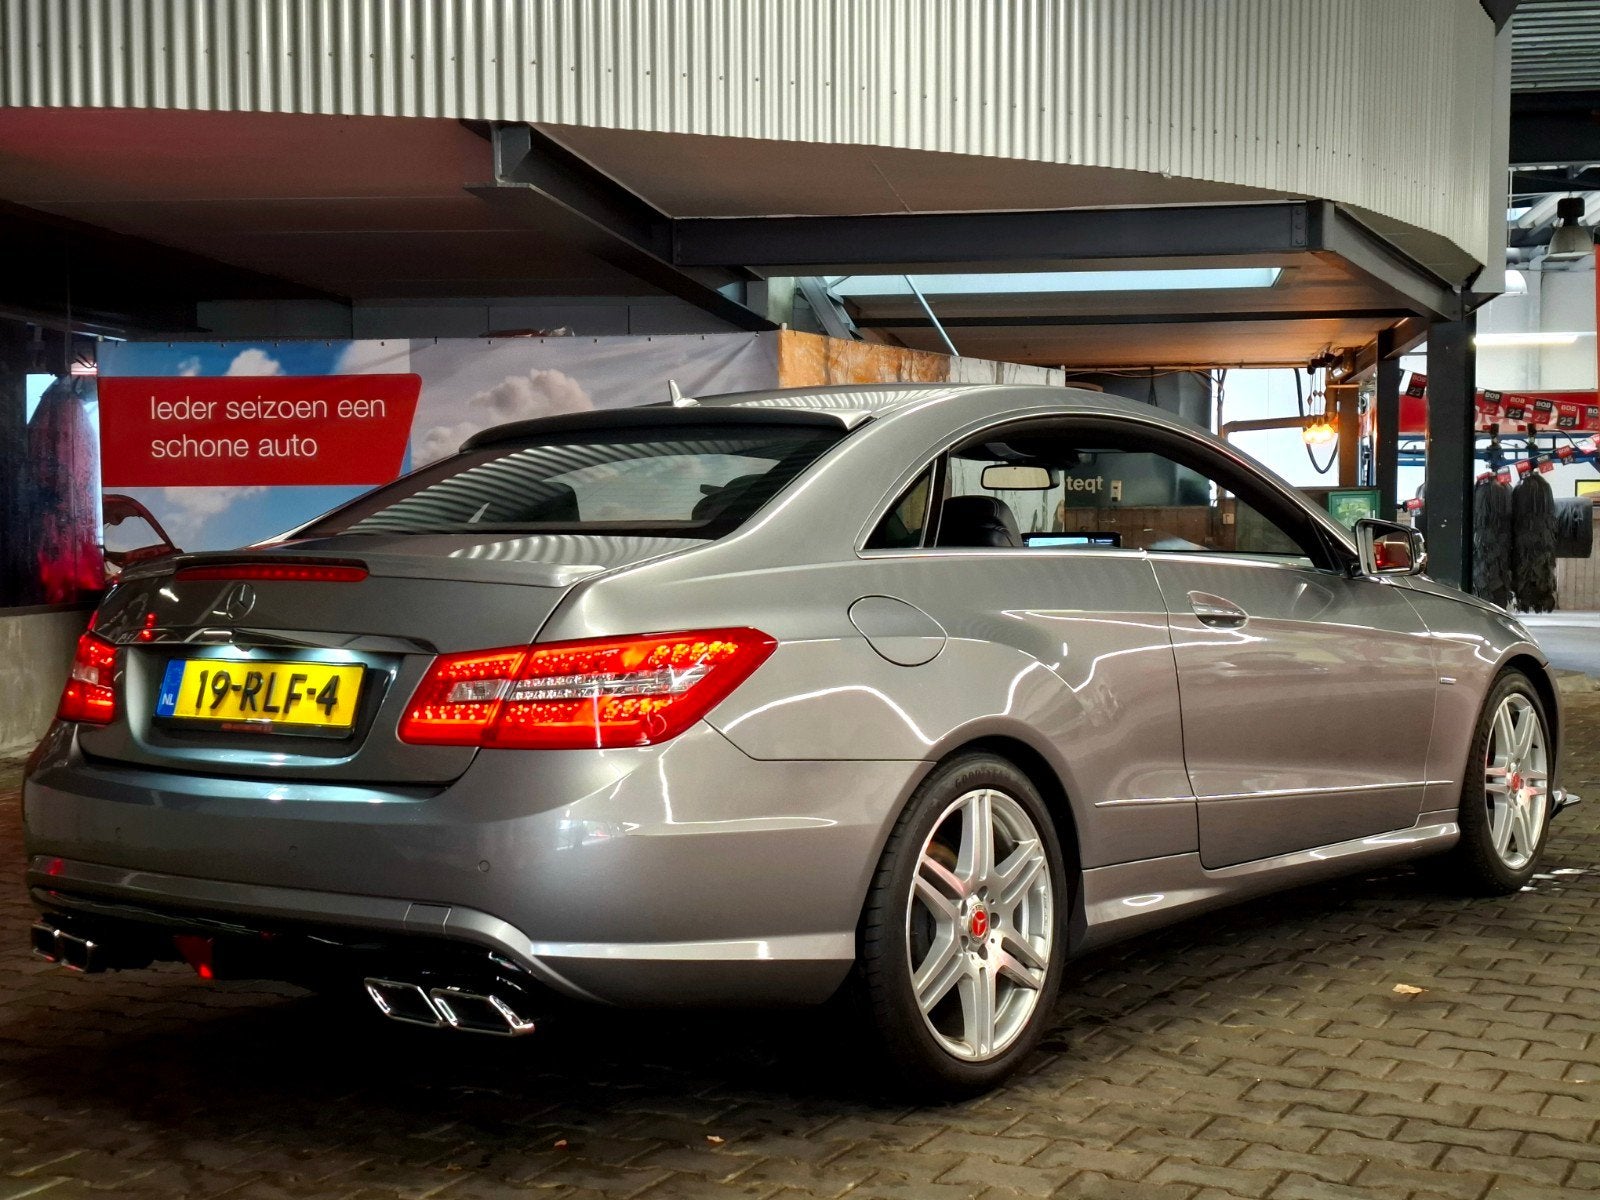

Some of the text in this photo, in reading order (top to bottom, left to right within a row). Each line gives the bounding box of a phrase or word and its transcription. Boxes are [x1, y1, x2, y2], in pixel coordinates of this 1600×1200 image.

[1409, 387, 1422, 396] 25
[1484, 391, 1500, 400] BOB
[151, 395, 386, 420] Ieder seizoen een
[1536, 401, 1551, 409] BOB
[1508, 409, 1522, 418] 25
[1587, 407, 1598, 415] BO
[1534, 413, 1547, 423] 25
[1559, 417, 1573, 426] 25
[151, 434, 317, 459] schone auto
[1066, 475, 1104, 493] teqt
[161, 669, 340, 716] NL 19-RLF-4
